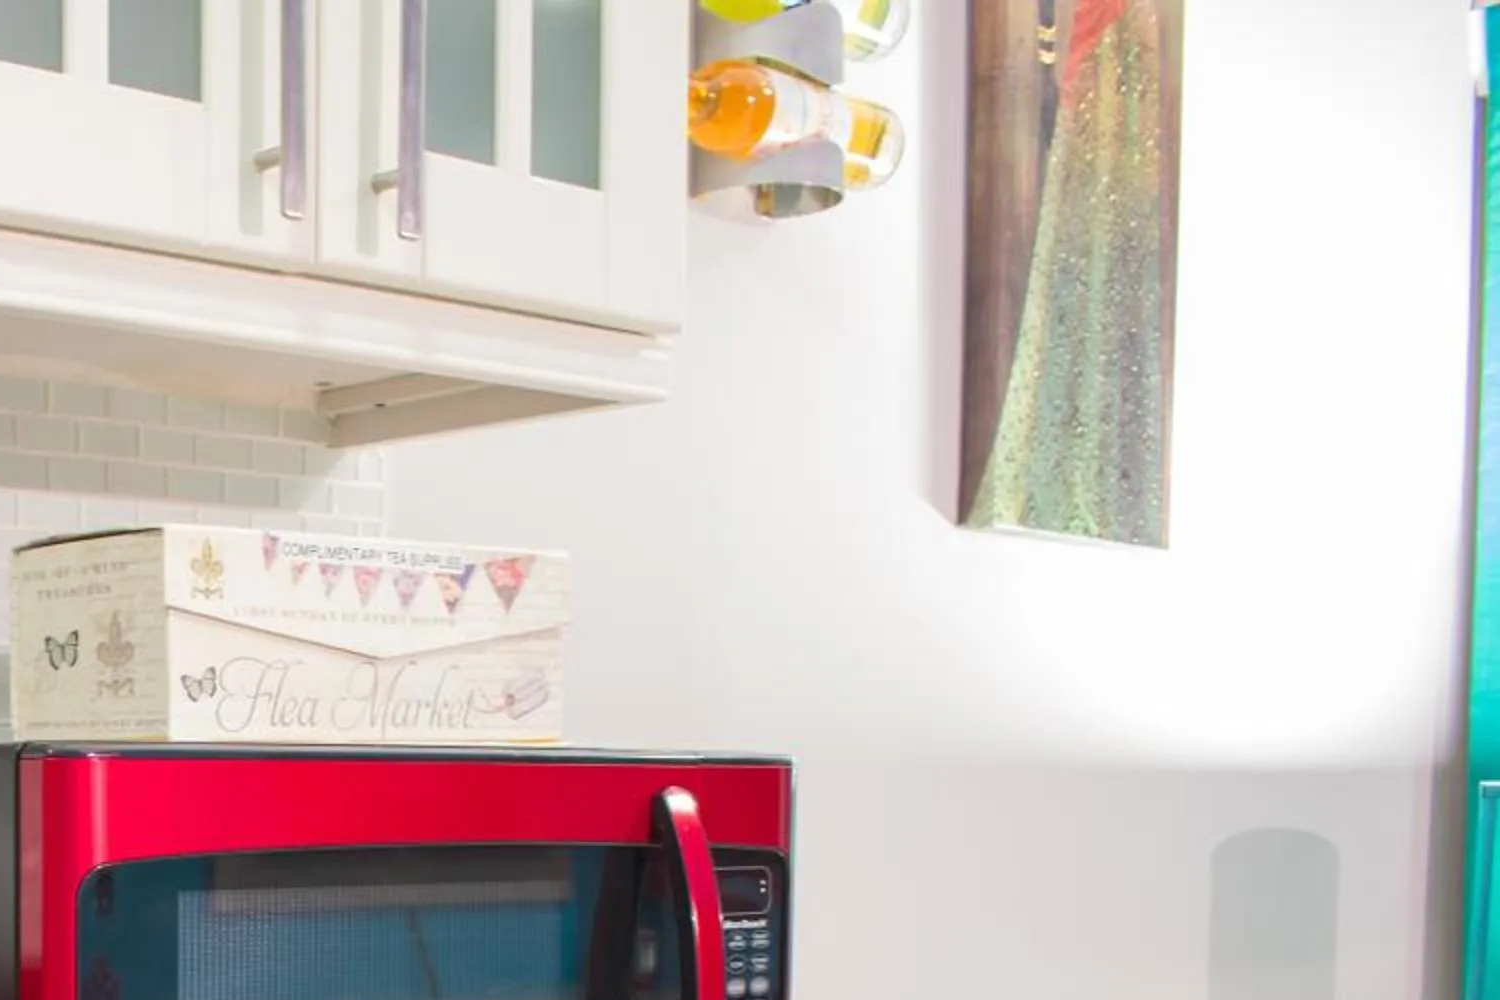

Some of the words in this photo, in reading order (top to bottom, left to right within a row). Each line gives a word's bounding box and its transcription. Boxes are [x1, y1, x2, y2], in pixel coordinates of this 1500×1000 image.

[281, 541, 382, 561] COMPLIMENTARY
[387, 550, 405, 565] TEA
[215, 656, 318, 733] Flea
[331, 660, 474, 739] Market
